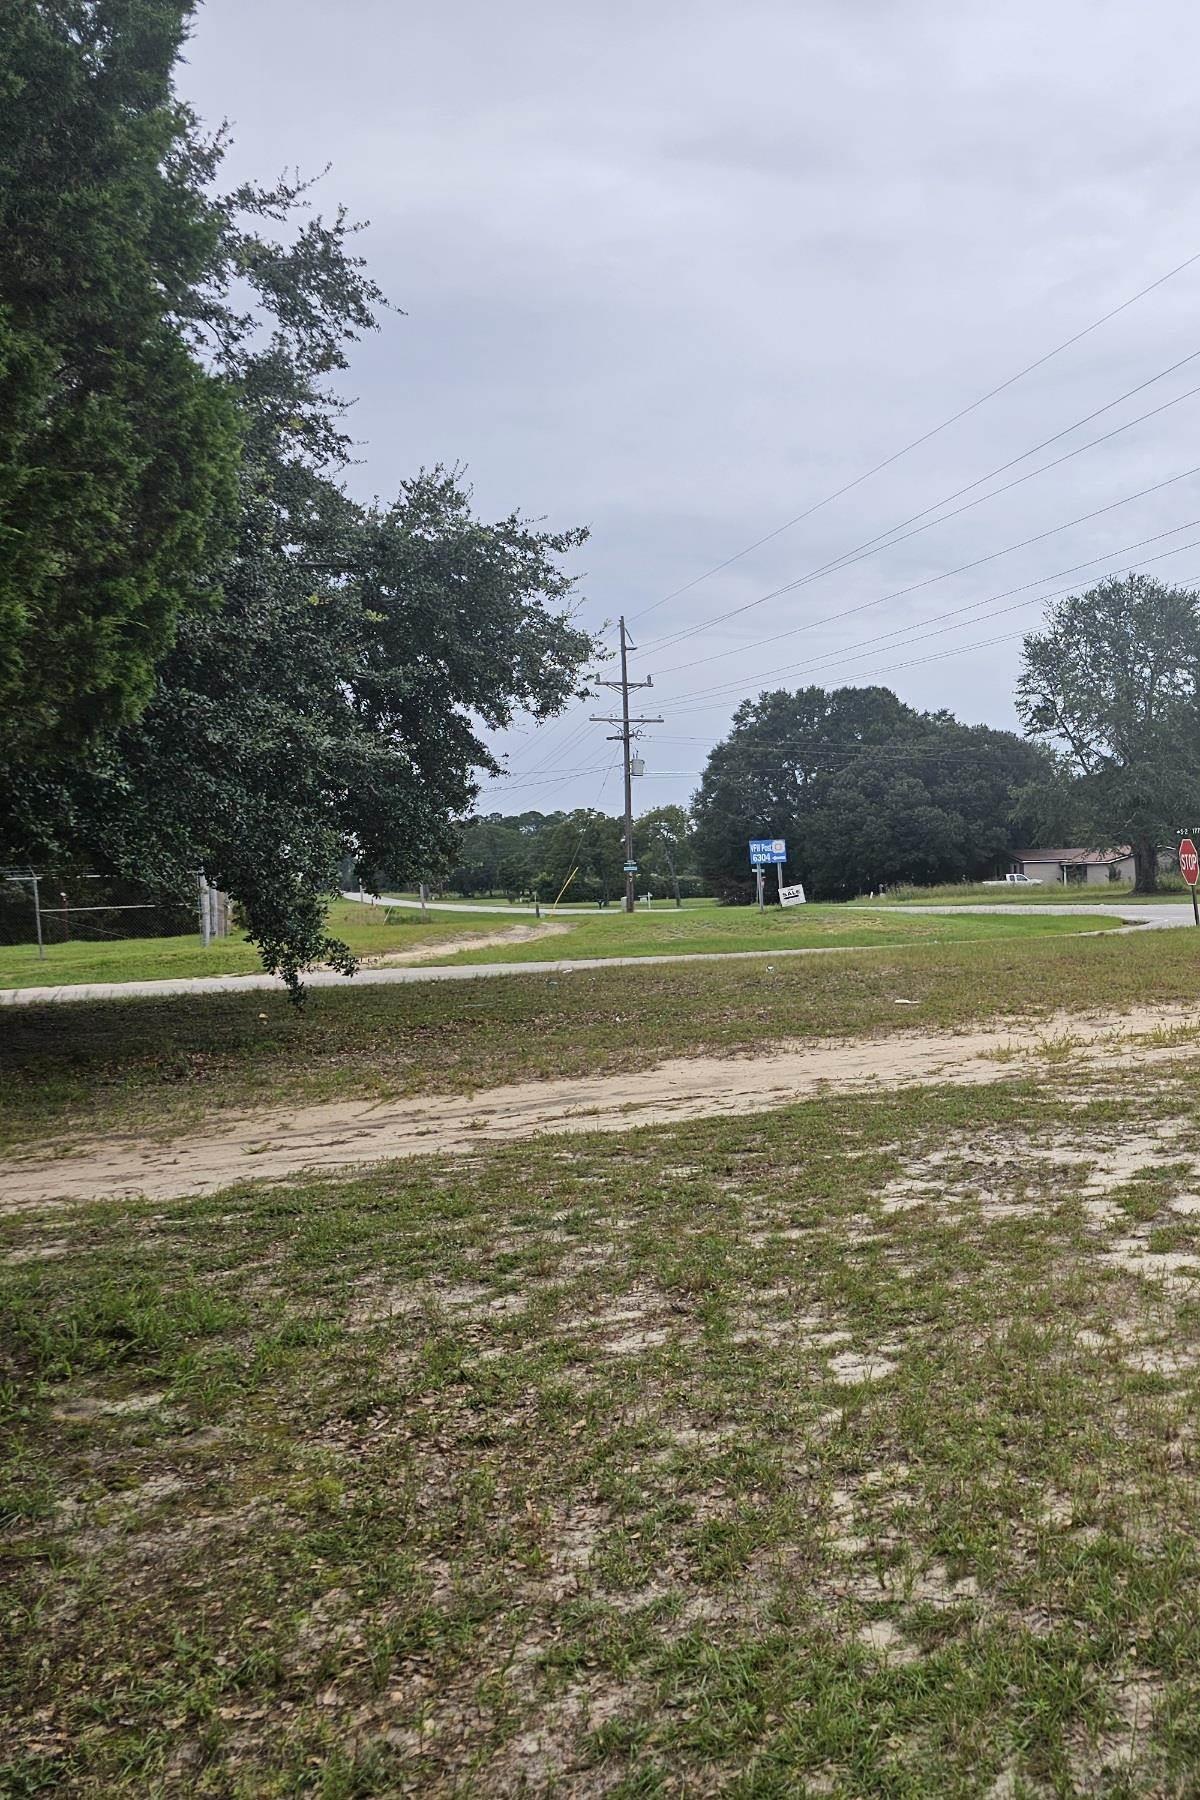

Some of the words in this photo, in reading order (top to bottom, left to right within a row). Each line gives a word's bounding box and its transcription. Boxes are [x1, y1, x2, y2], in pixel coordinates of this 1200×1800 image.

[753, 853, 771, 862] 6304
[1181, 854, 1197, 870] STOP
[782, 889, 801, 897] SALE
